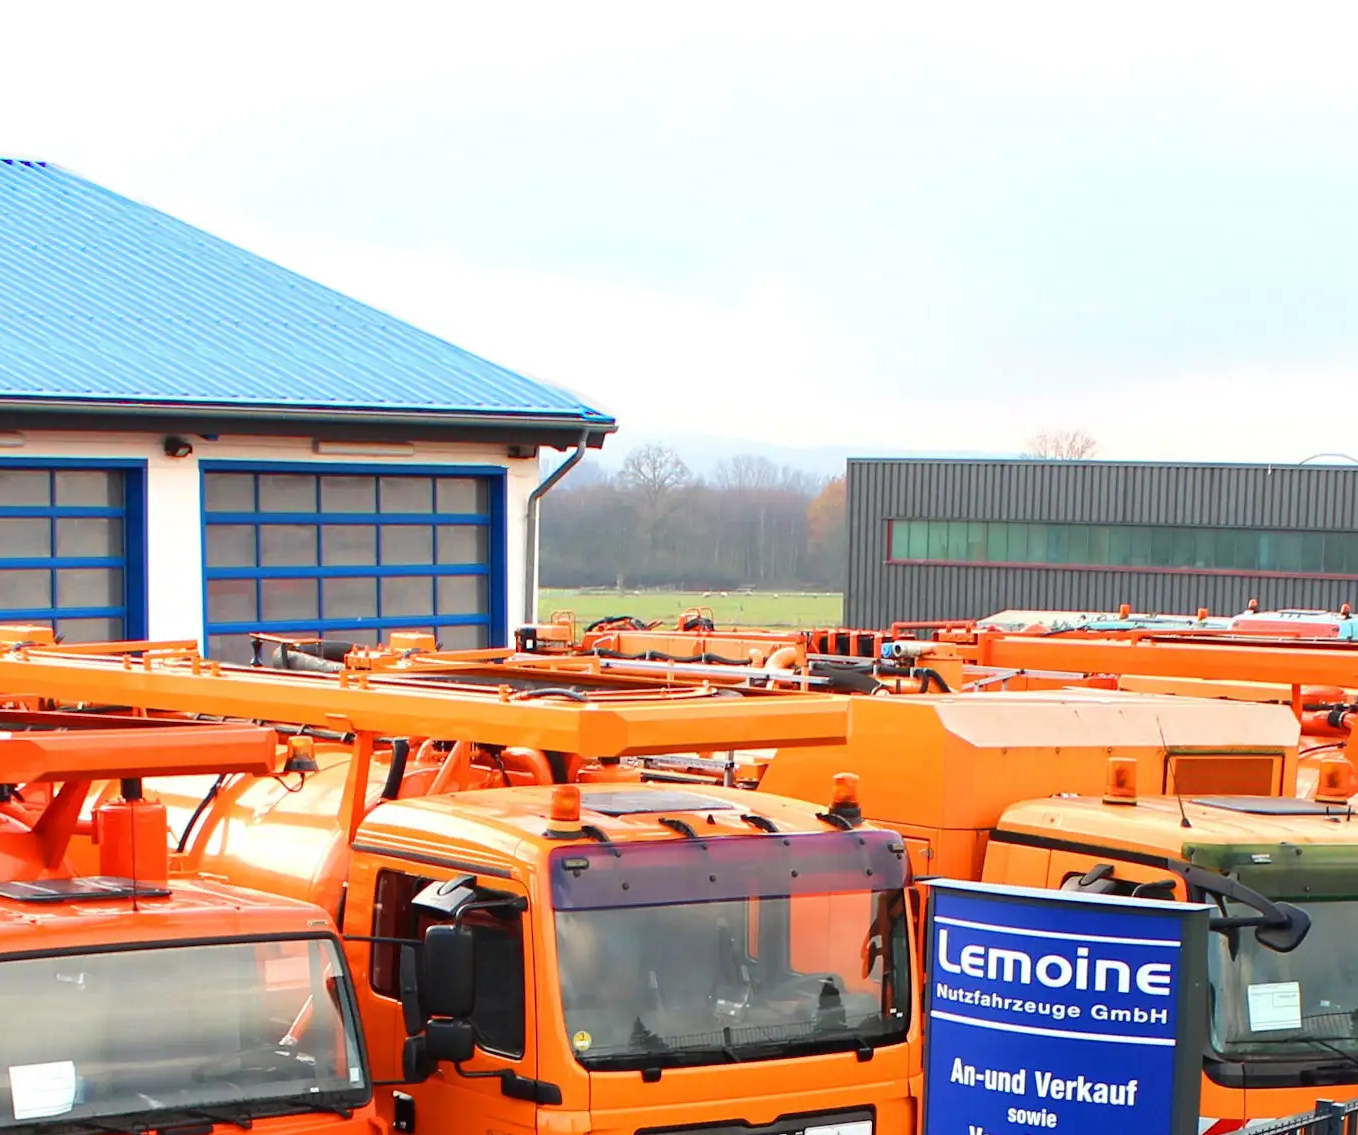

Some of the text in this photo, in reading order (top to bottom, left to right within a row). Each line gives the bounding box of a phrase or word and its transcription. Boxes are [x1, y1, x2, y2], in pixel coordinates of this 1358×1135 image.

[939, 929, 1171, 995] Lemoine
[937, 983, 1167, 1023] Nutzfahrzeuge GmbH
[951, 1058, 1137, 1105] An-und Verkauf
[1008, 1108, 1057, 1127] sowie
